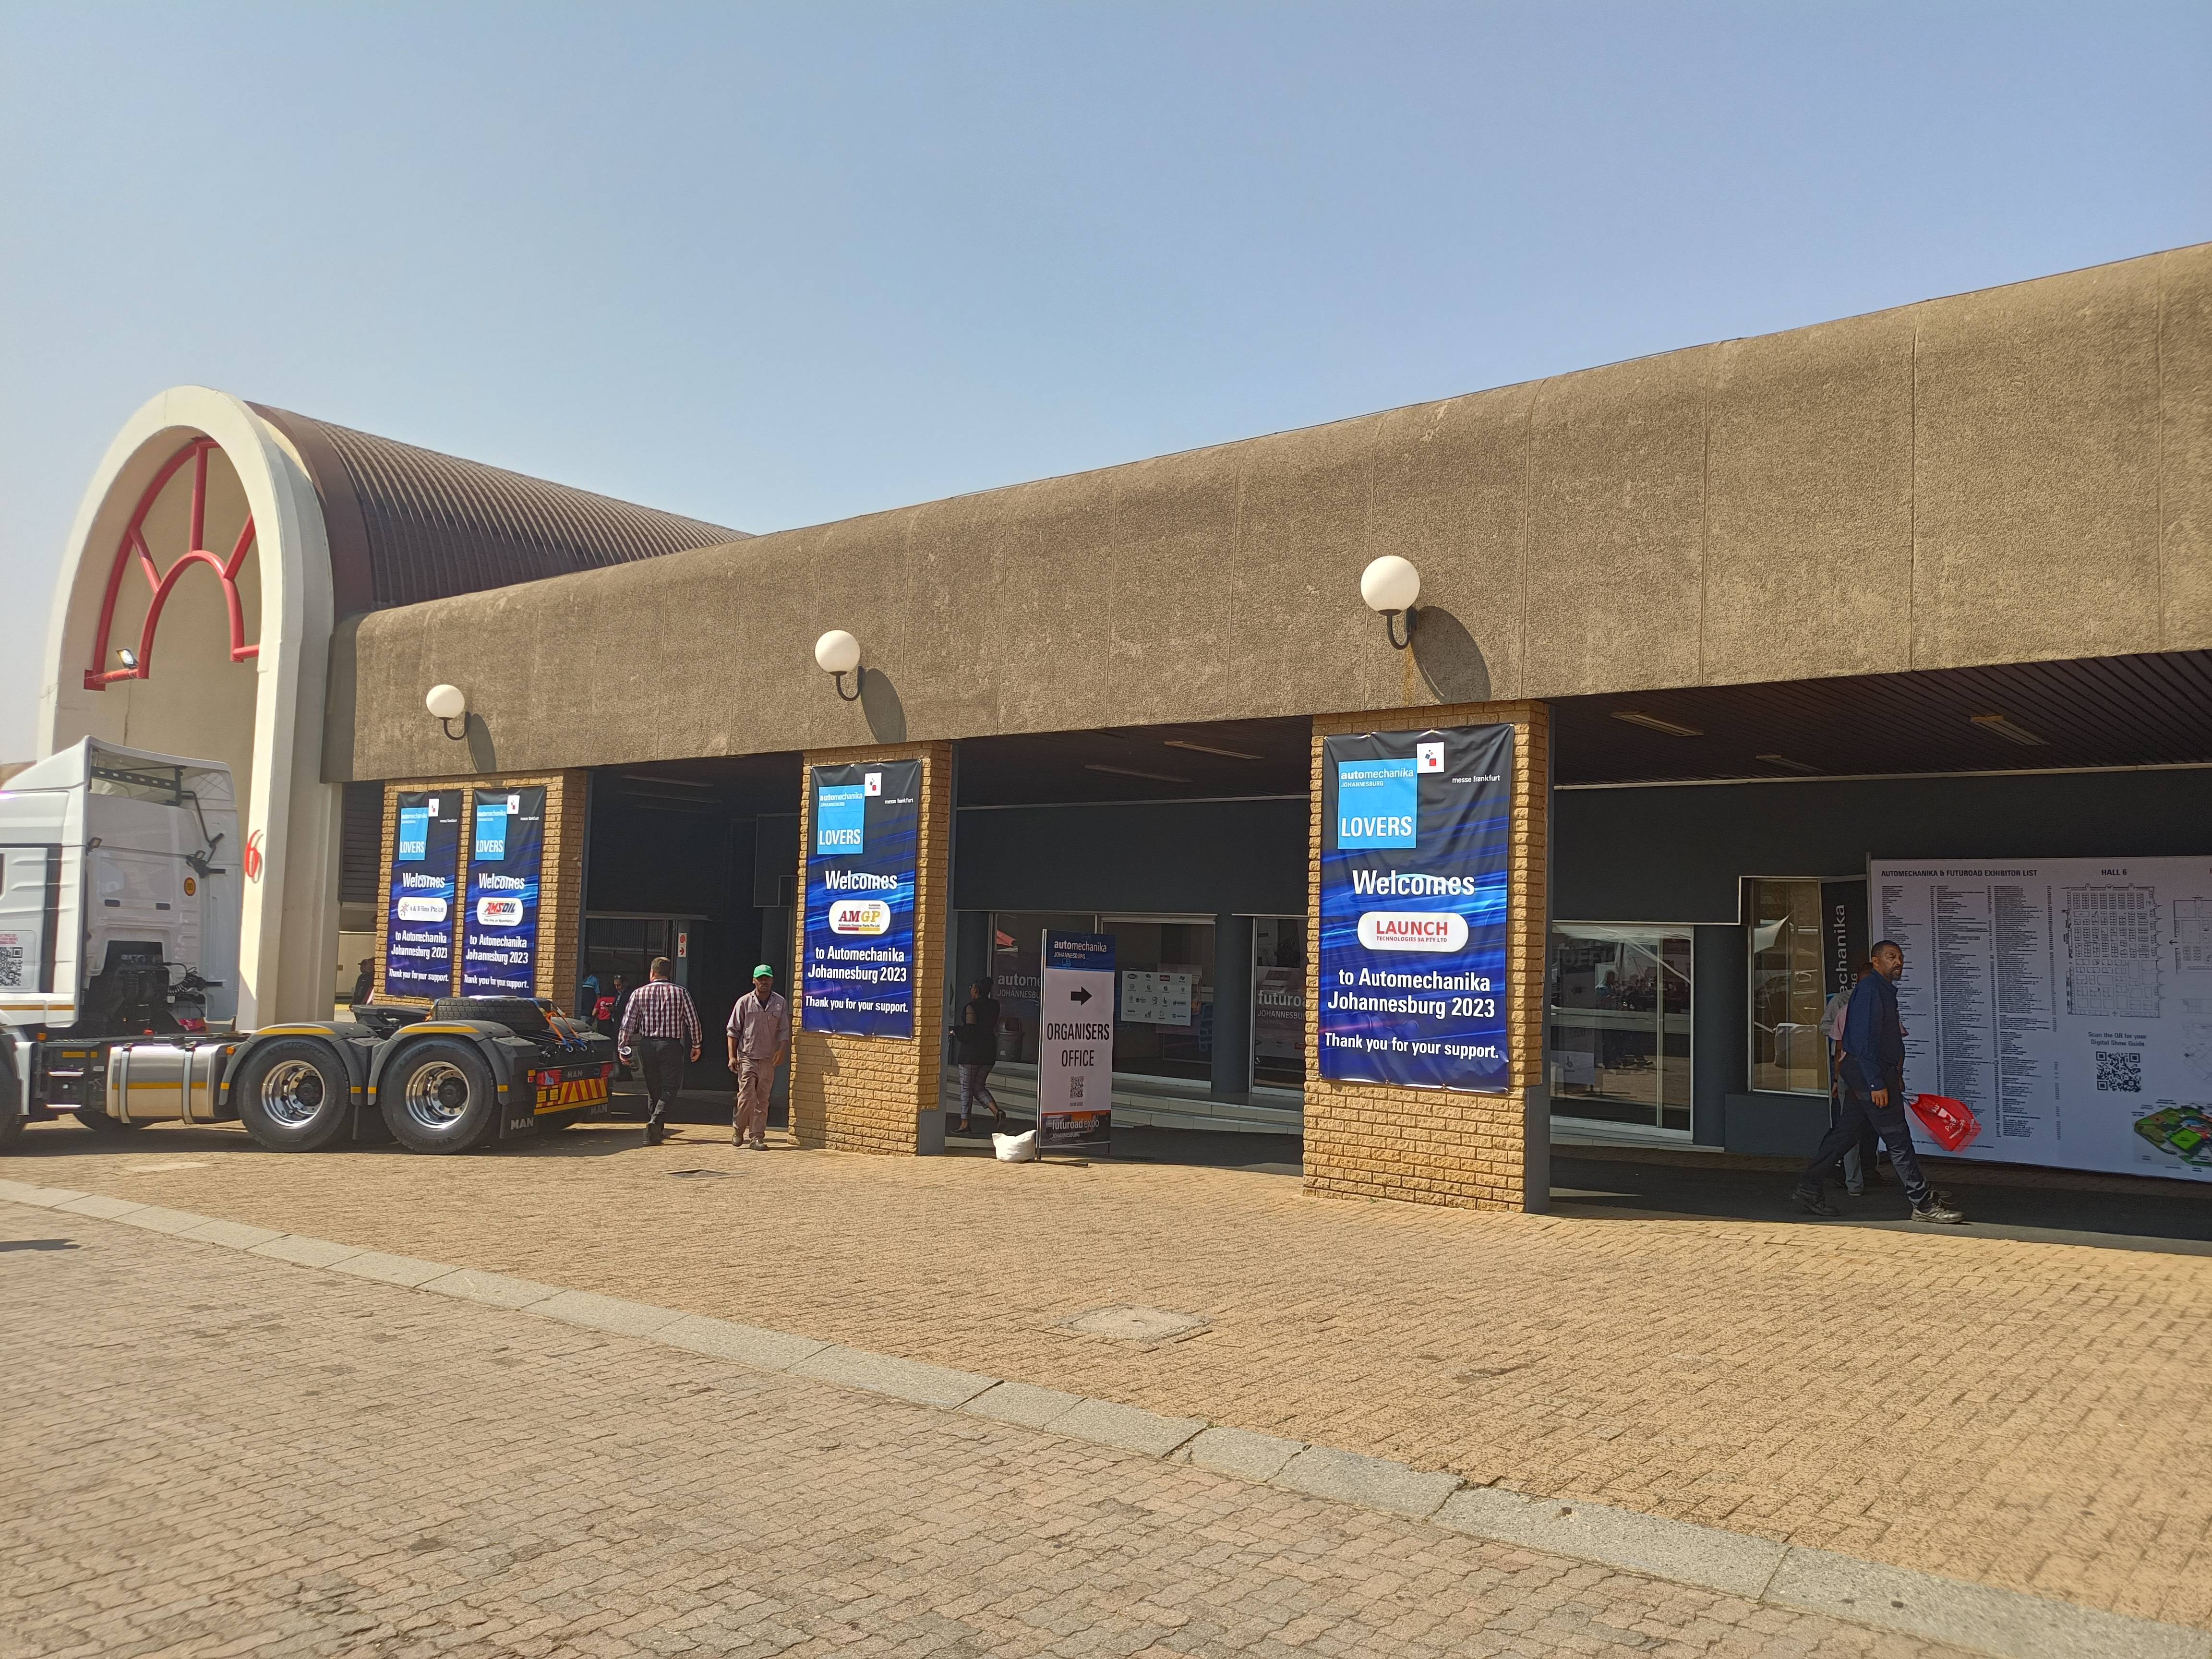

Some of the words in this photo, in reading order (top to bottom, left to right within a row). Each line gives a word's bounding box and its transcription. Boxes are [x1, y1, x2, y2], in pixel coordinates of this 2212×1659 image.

[1341, 768, 1414, 780] automechanika
[1452, 776, 1471, 784] messe
[1473, 774, 1501, 782] frankfurt
[819, 792, 863, 801] automechanika
[1341, 816, 1412, 837] LOVERS
[819, 829, 861, 845] LOVERS
[400, 841, 424, 853] LOVERS
[476, 840, 504, 853] LOVERS
[402, 873, 445, 888] Welcomes
[479, 873, 525, 890] Welcomes
[825, 870, 898, 890] Welcomes
[1352, 869, 1475, 896] Welcomes
[484, 902, 516, 914] AMSOIL
[838, 911, 880, 922] AMGP
[1376, 921, 1448, 936] LAUNCH
[396, 931, 401, 940] to
[402, 930, 446, 943] Automechanika
[469, 935, 477, 945] to
[479, 934, 527, 948] Automechanika
[391, 944, 430, 960] Johannesburg
[432, 947, 447, 959] 2023
[1054, 940, 1107, 952] automechanika
[1833, 904, 1848, 993] echanika
[466, 948, 508, 965] Johannesburg
[509, 951, 529, 964] 2023
[816, 947, 825, 959] to
[827, 946, 904, 962] Automechanika
[389, 968, 402, 977] Thank
[428, 974, 449, 983] support.
[464, 974, 478, 984] Thank
[479, 977, 489, 986] you
[506, 980, 529, 989] support.
[808, 964, 878, 984] Johannesburg
[880, 967, 907, 982] 2023
[1339, 970, 1354, 985] to
[1358, 968, 1491, 991] Automechanika
[806, 996, 829, 1008] Thank
[830, 999, 843, 1010] you
[845, 998, 856, 1009] for
[858, 1001, 874, 1012] your
[876, 1002, 908, 1014] support.
[1328, 991, 1446, 1020] Johannesburg
[1451, 997, 1495, 1018] 2023
[1258, 1010, 1305, 1020] JOHANNESBU
[1047, 1023, 1109, 1040] ORGANISERS
[1325, 1033, 1362, 1048] Thank
[1366, 1038, 1387, 1052] you
[1392, 1037, 1408, 1052] for
[1411, 1043, 1441, 1056] your
[1444, 1044, 1499, 1060] support.
[1061, 1049, 1094, 1067] OFFICE
[567, 1070, 583, 1078] MAN
[590, 1105, 608, 1115] MAN
[511, 1117, 534, 1130] MAN
[1052, 1118, 1083, 1130] futuroad
[1084, 1119, 1099, 1130] expo
